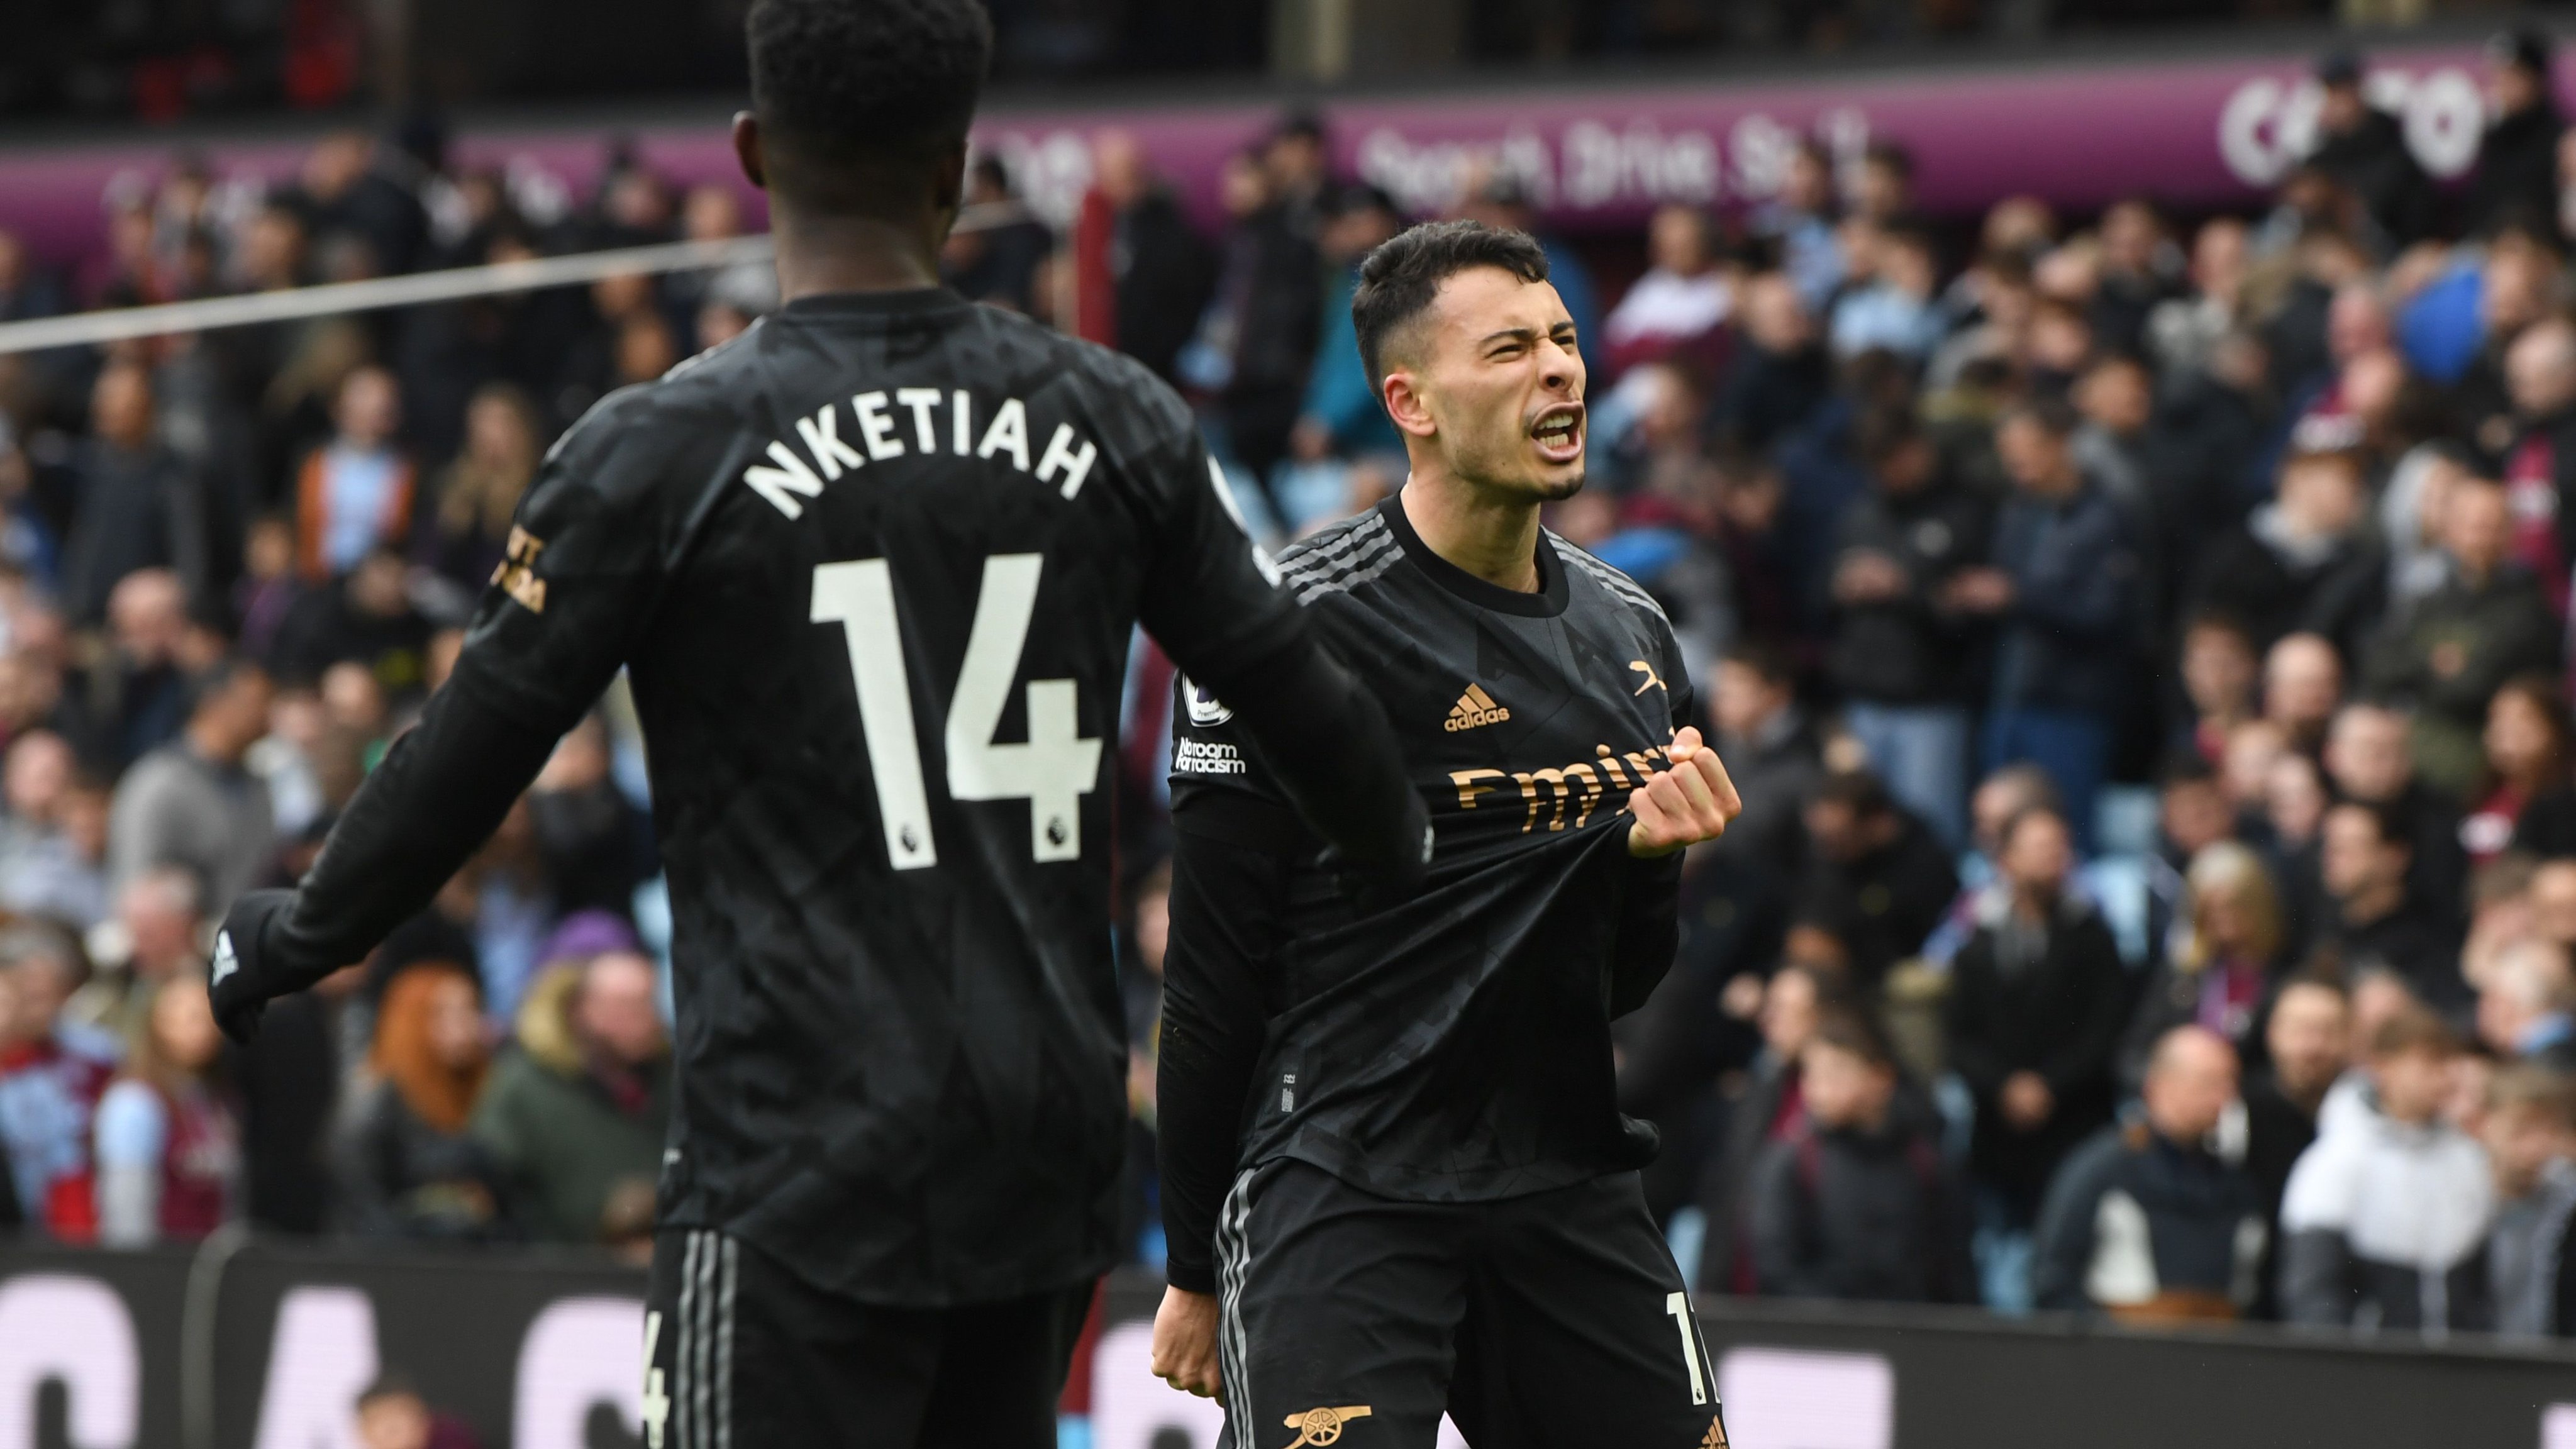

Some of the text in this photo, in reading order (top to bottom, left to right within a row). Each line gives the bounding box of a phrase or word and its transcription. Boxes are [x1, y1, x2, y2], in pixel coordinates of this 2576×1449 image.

[743, 387, 1098, 521] NKETIAH
[809, 552, 1104, 871] 14
[1197, 705, 1223, 718] Premier
[1443, 707, 1511, 733] adidas
[1192, 742, 1238, 758] room
[1191, 758, 1246, 774] racism
